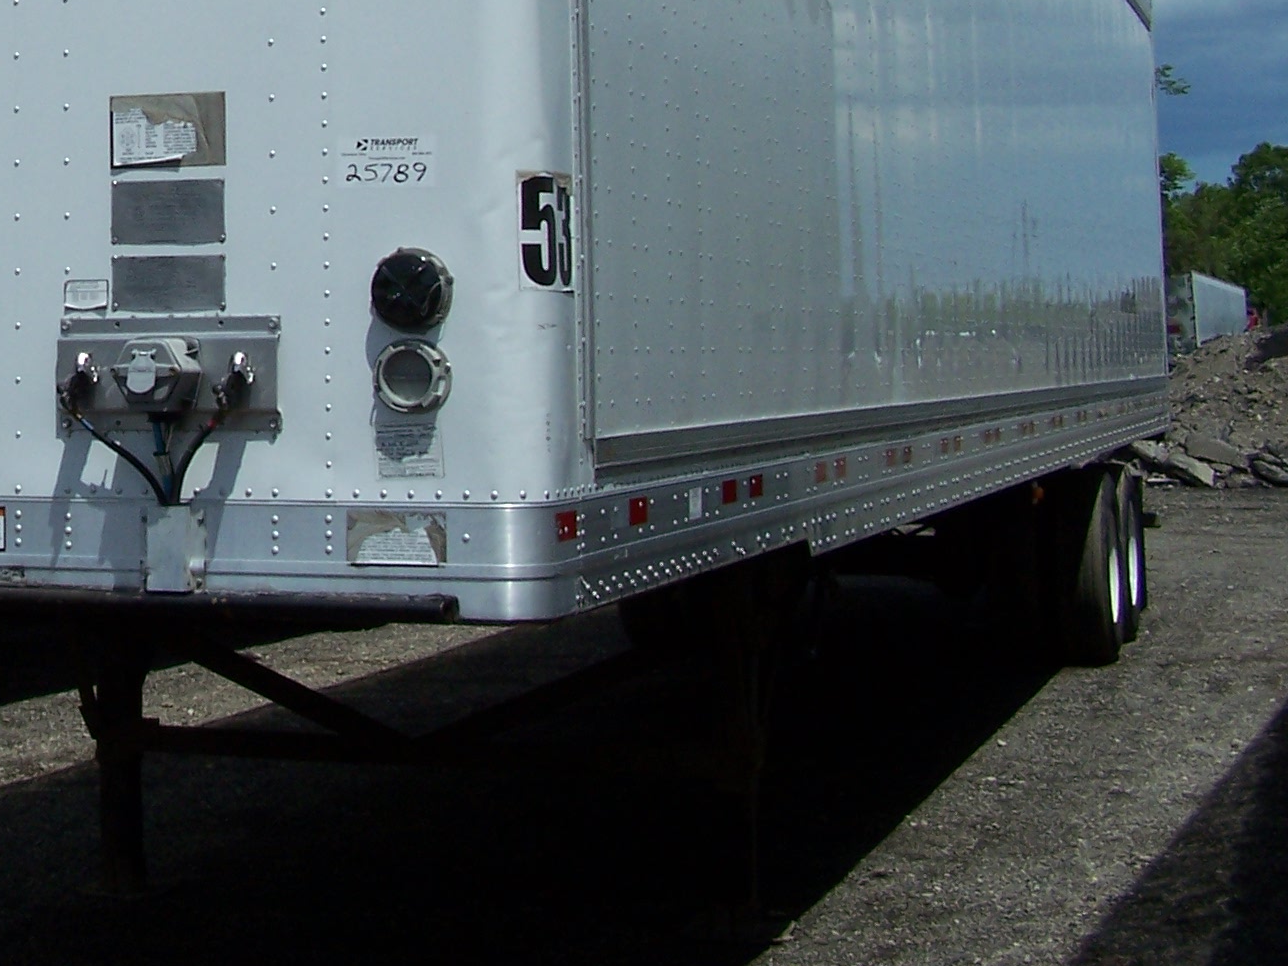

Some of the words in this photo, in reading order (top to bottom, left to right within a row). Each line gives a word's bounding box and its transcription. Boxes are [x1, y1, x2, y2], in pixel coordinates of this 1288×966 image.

[371, 138, 418, 146] TRANSPORT
[346, 162, 427, 183] 25789
[521, 176, 572, 286] 53
